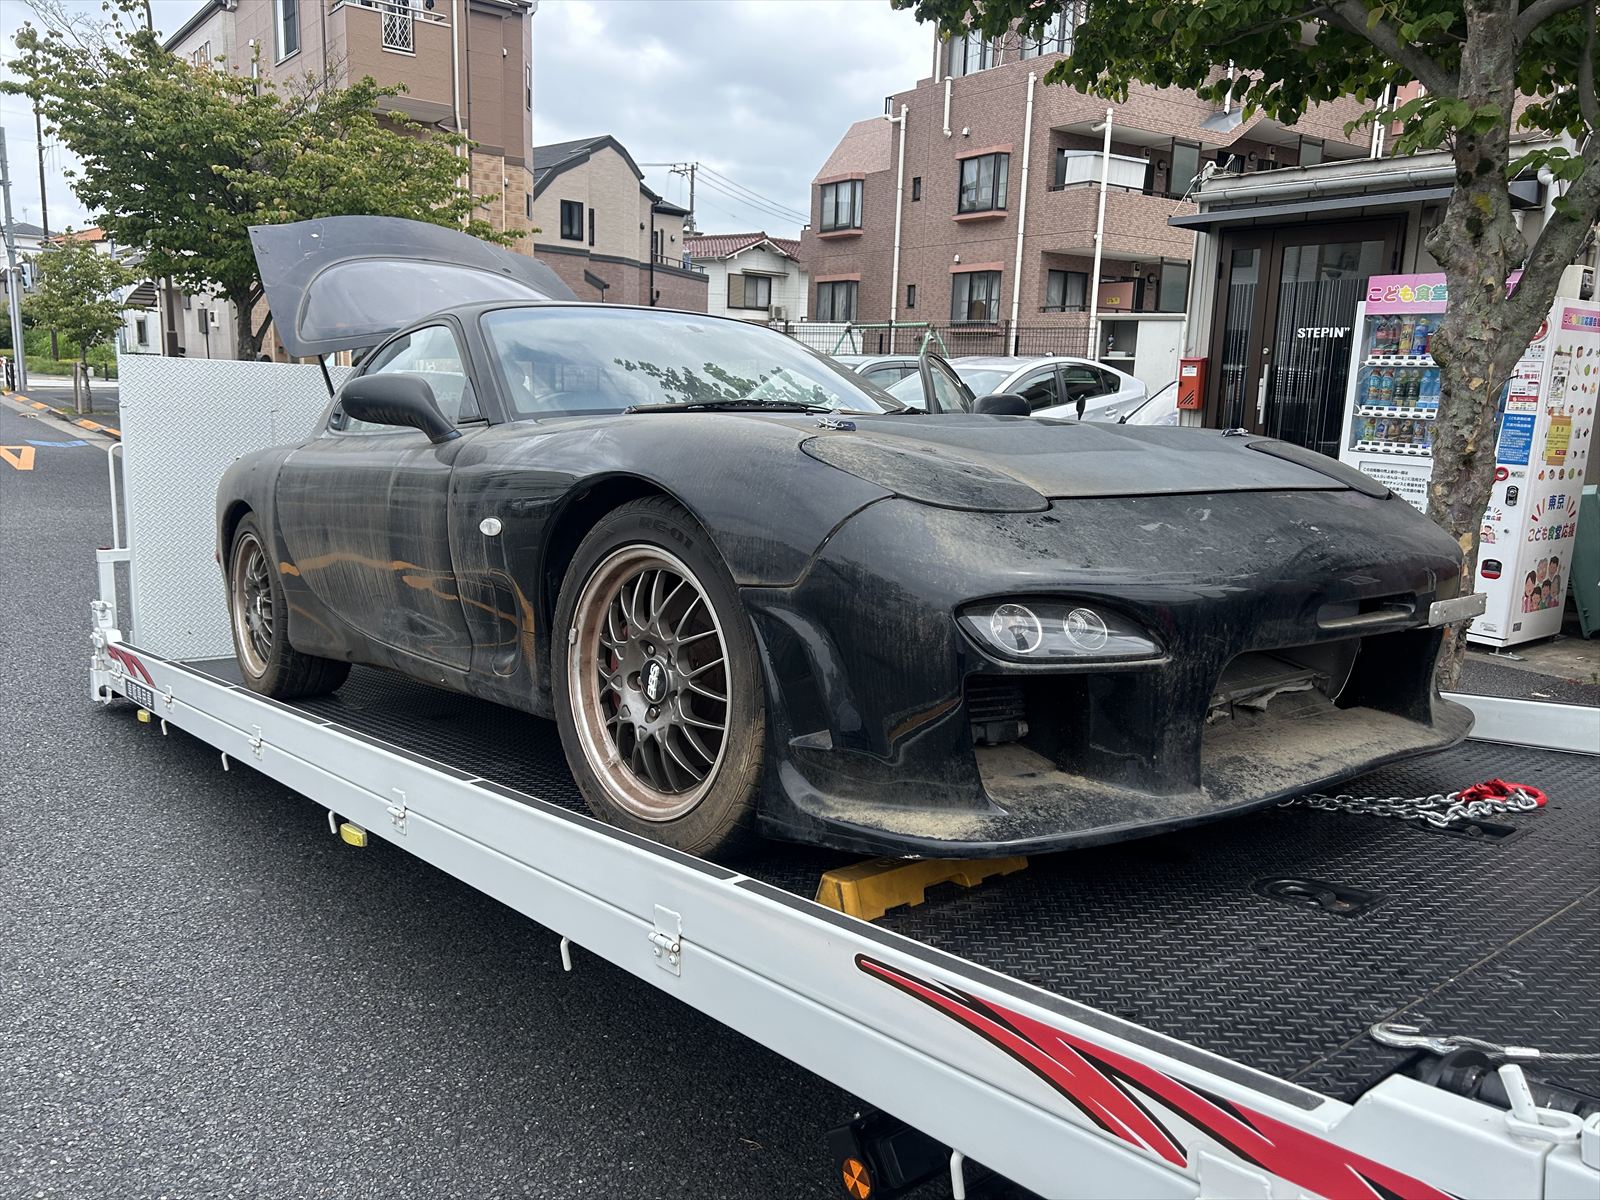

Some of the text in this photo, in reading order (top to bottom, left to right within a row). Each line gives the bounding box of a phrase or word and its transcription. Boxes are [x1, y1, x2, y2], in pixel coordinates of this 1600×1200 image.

[1548, 494, 1566, 510] 東京
[1528, 522, 1575, 542] こども食堂応援
[647, 663, 660, 700] BBS
